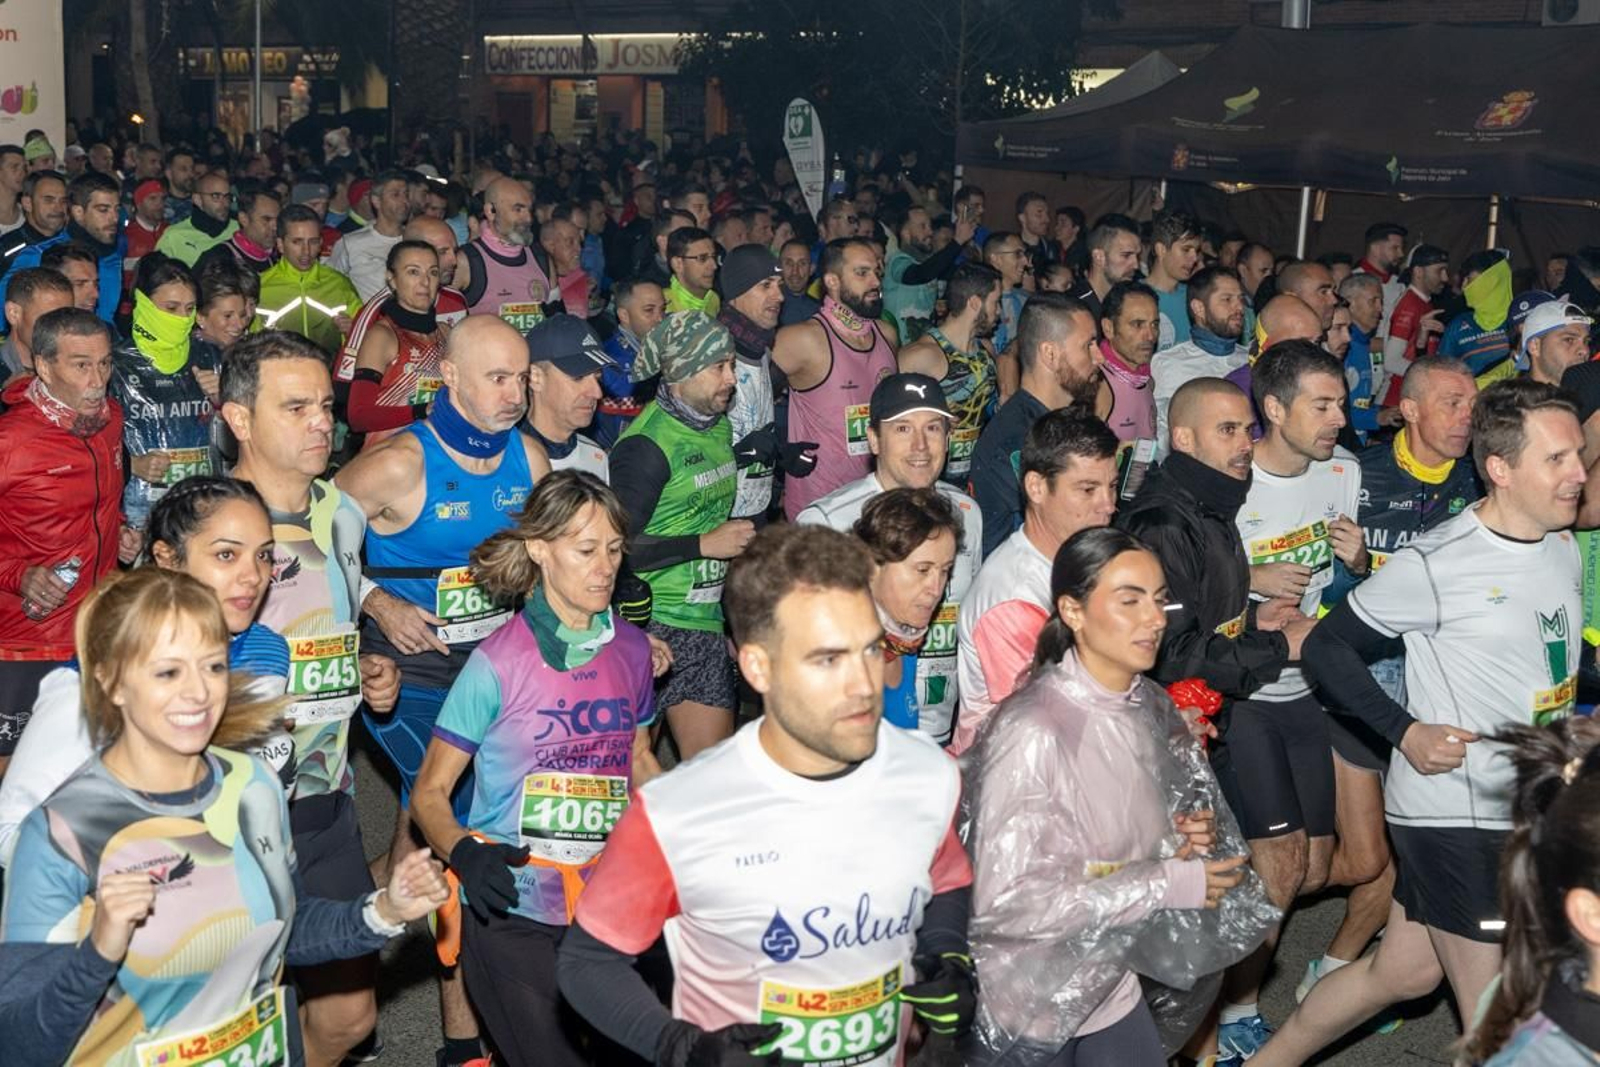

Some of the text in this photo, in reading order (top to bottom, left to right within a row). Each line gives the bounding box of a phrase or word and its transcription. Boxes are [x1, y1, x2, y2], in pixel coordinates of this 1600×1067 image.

[130, 402, 165, 420] SAN
[287, 656, 356, 692] 1645
[572, 670, 597, 681] vive
[533, 797, 623, 832] 1065
[799, 886, 918, 960] Salud
[797, 992, 828, 1012] 42
[770, 1001, 896, 1060] 2693
[178, 1036, 209, 1060] 42
